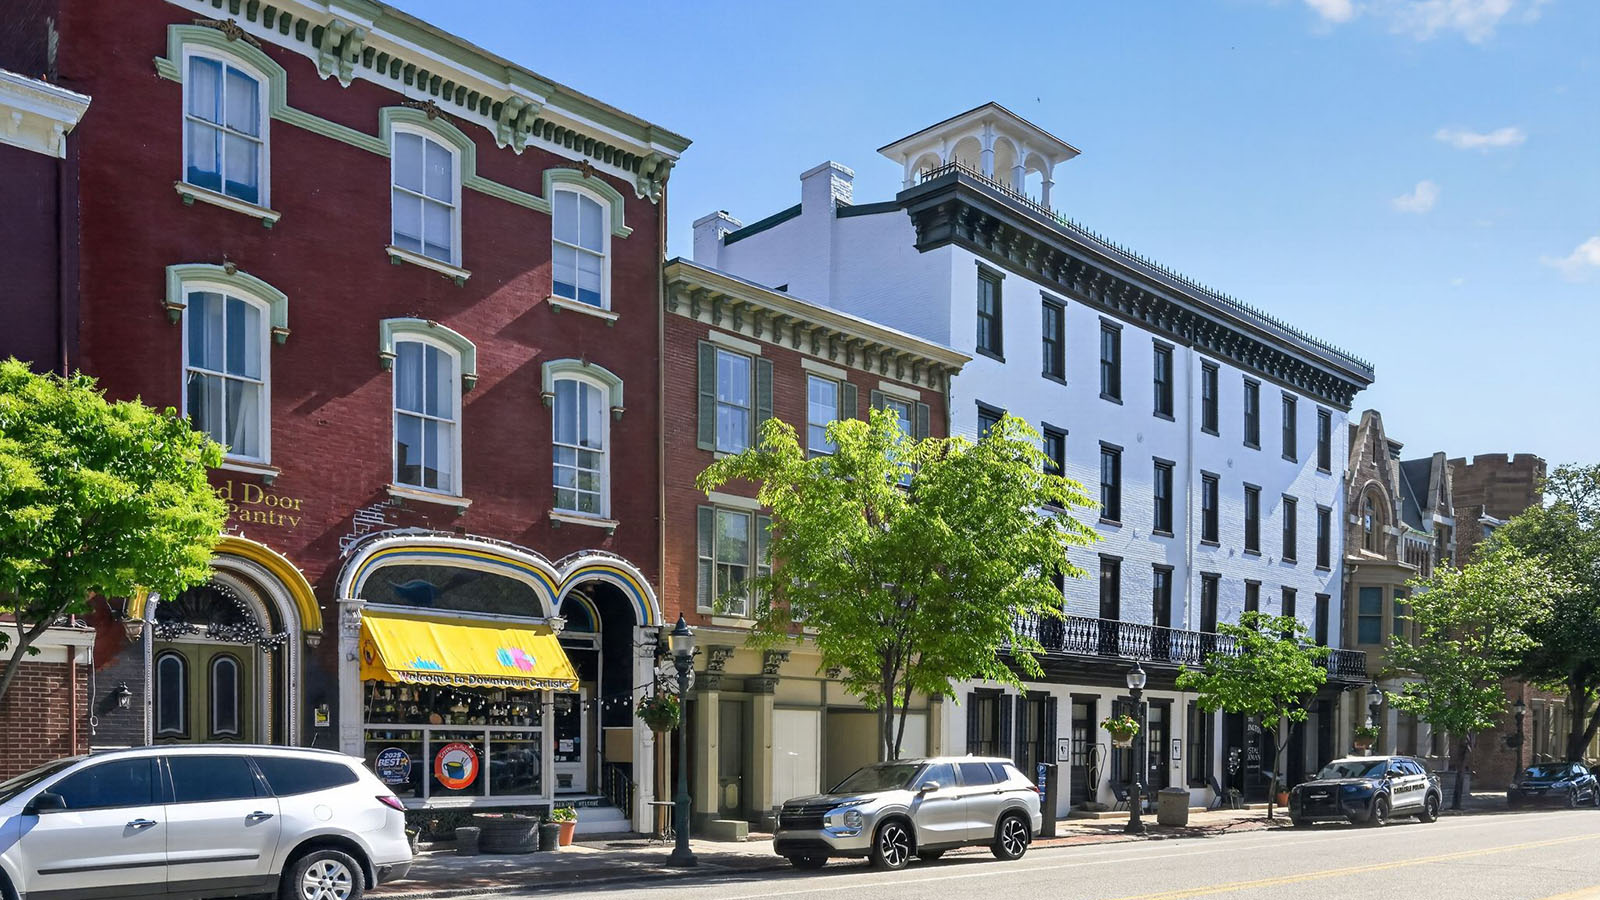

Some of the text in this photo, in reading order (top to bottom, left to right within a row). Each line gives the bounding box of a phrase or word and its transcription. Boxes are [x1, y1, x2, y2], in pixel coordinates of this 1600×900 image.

[241, 482, 303, 511] Door
[396, 671, 450, 684] Welcome
[454, 674, 464, 683] to
[468, 675, 527, 688] Downtown
[378, 759, 400, 767] BEST
